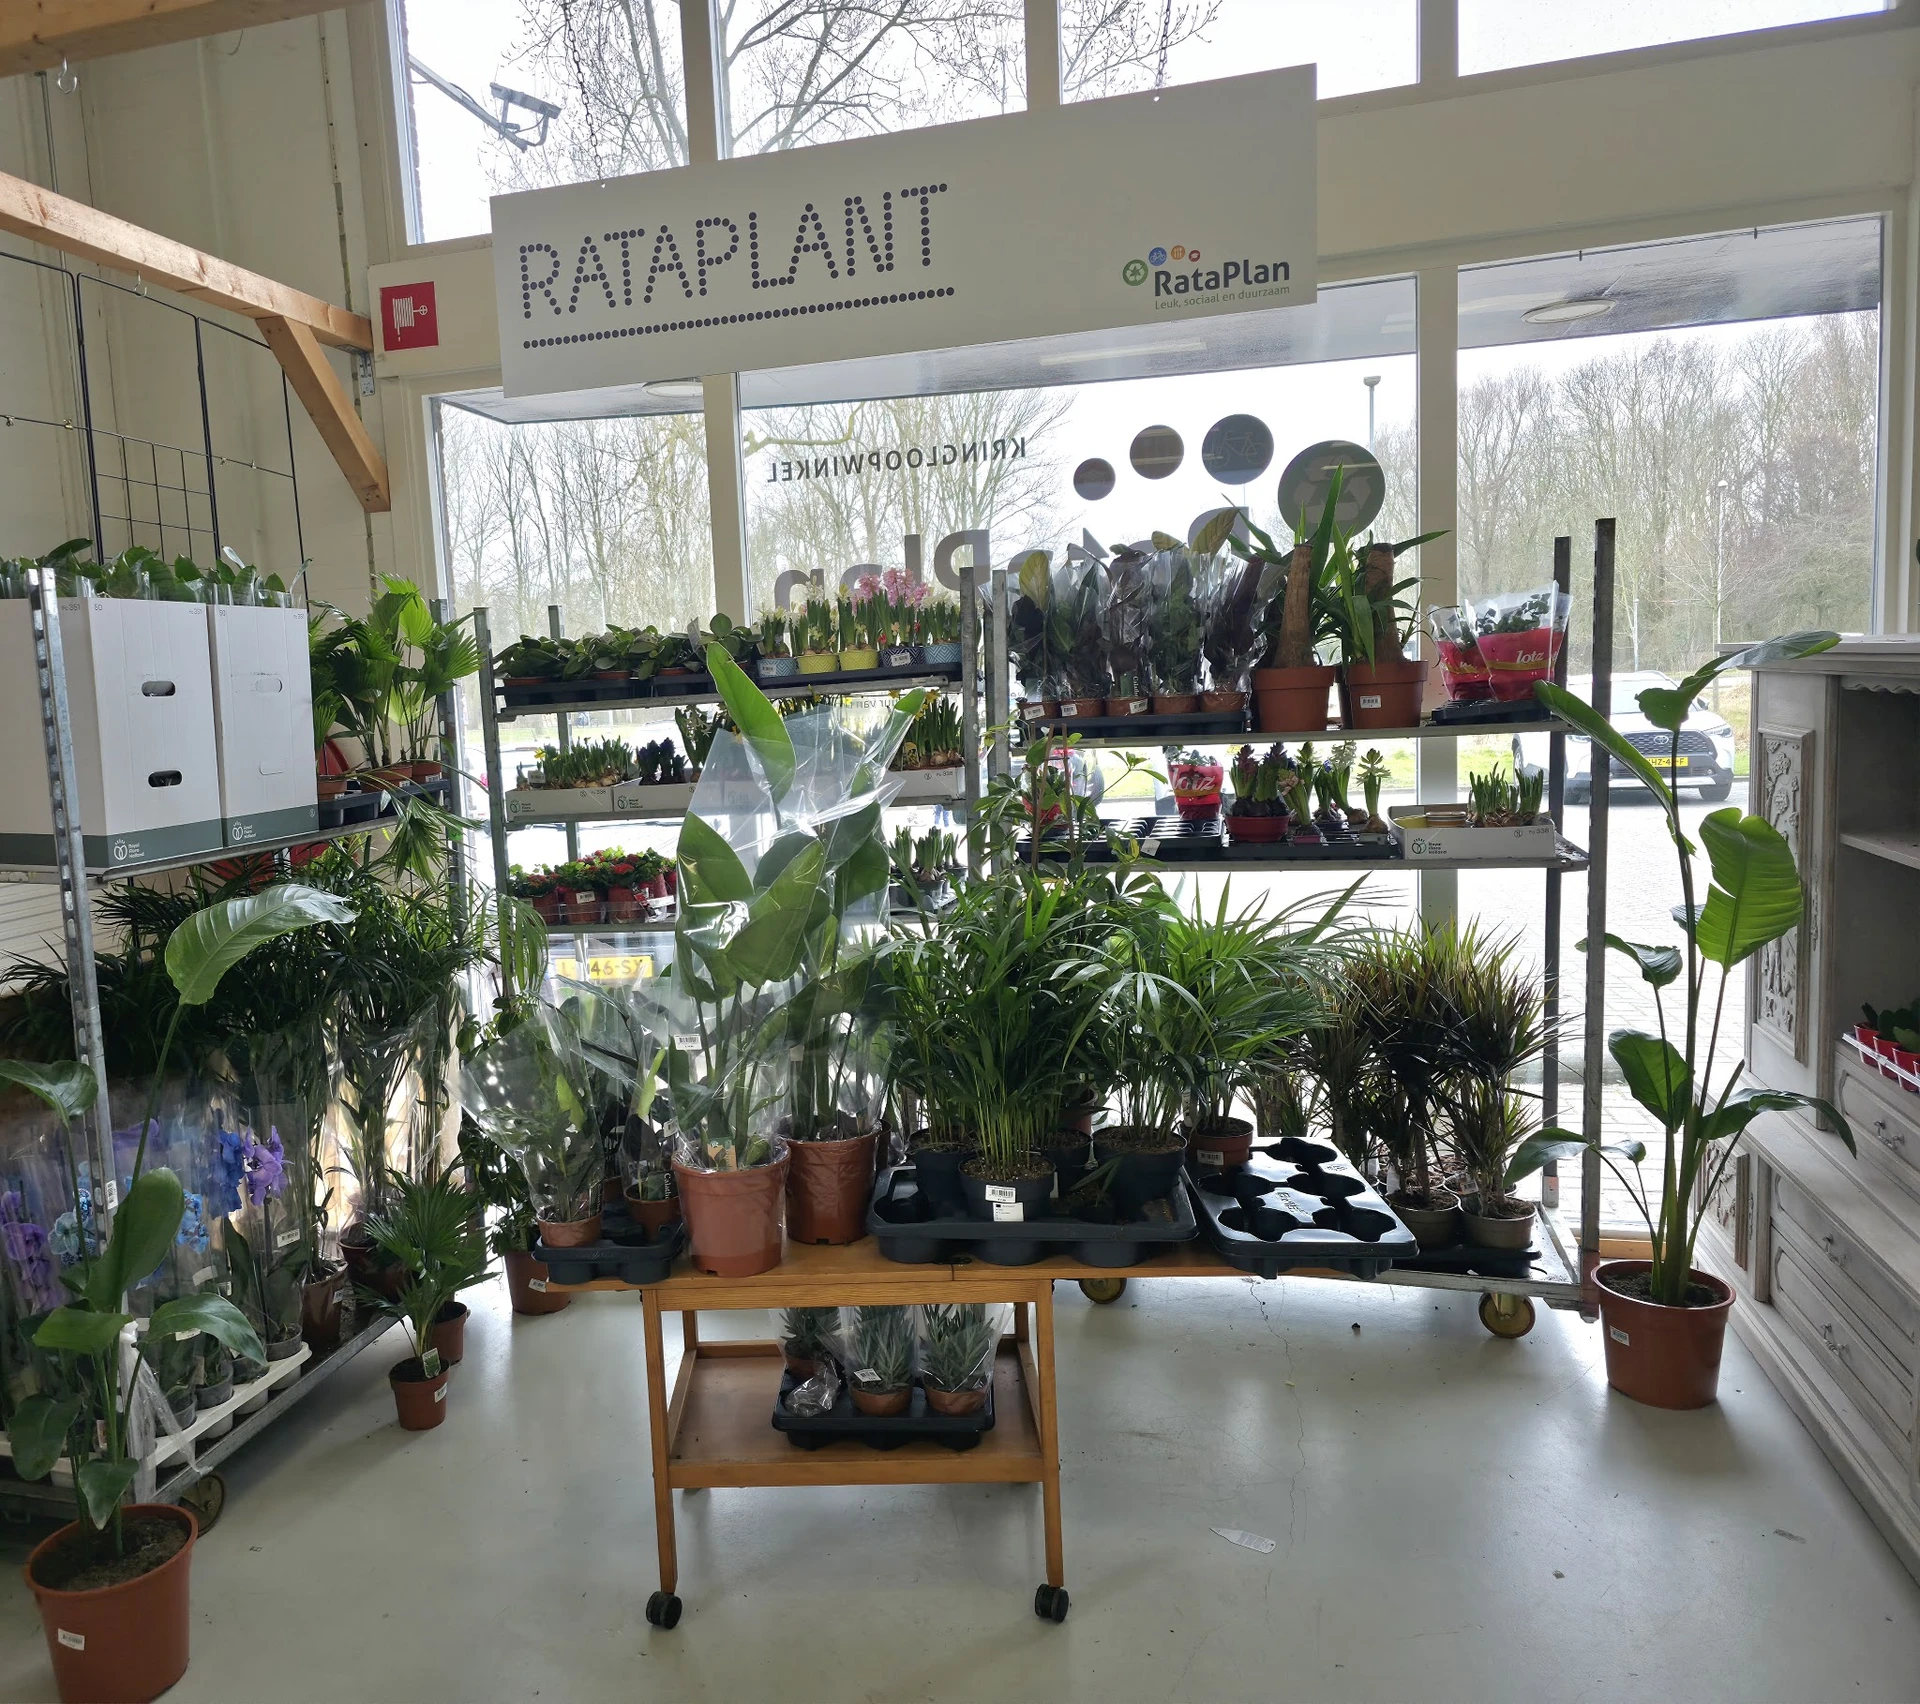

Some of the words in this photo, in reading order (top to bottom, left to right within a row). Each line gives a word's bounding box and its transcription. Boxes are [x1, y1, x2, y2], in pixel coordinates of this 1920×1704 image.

[519, 183, 948, 319] RATAPLANT
[1154, 259, 1290, 297] RataPlan
[1155, 300, 1182, 310] Leuk,
[1184, 293, 1220, 307] sociaal
[1222, 294, 1236, 302] en
[1238, 286, 1290, 300] duurzaam
